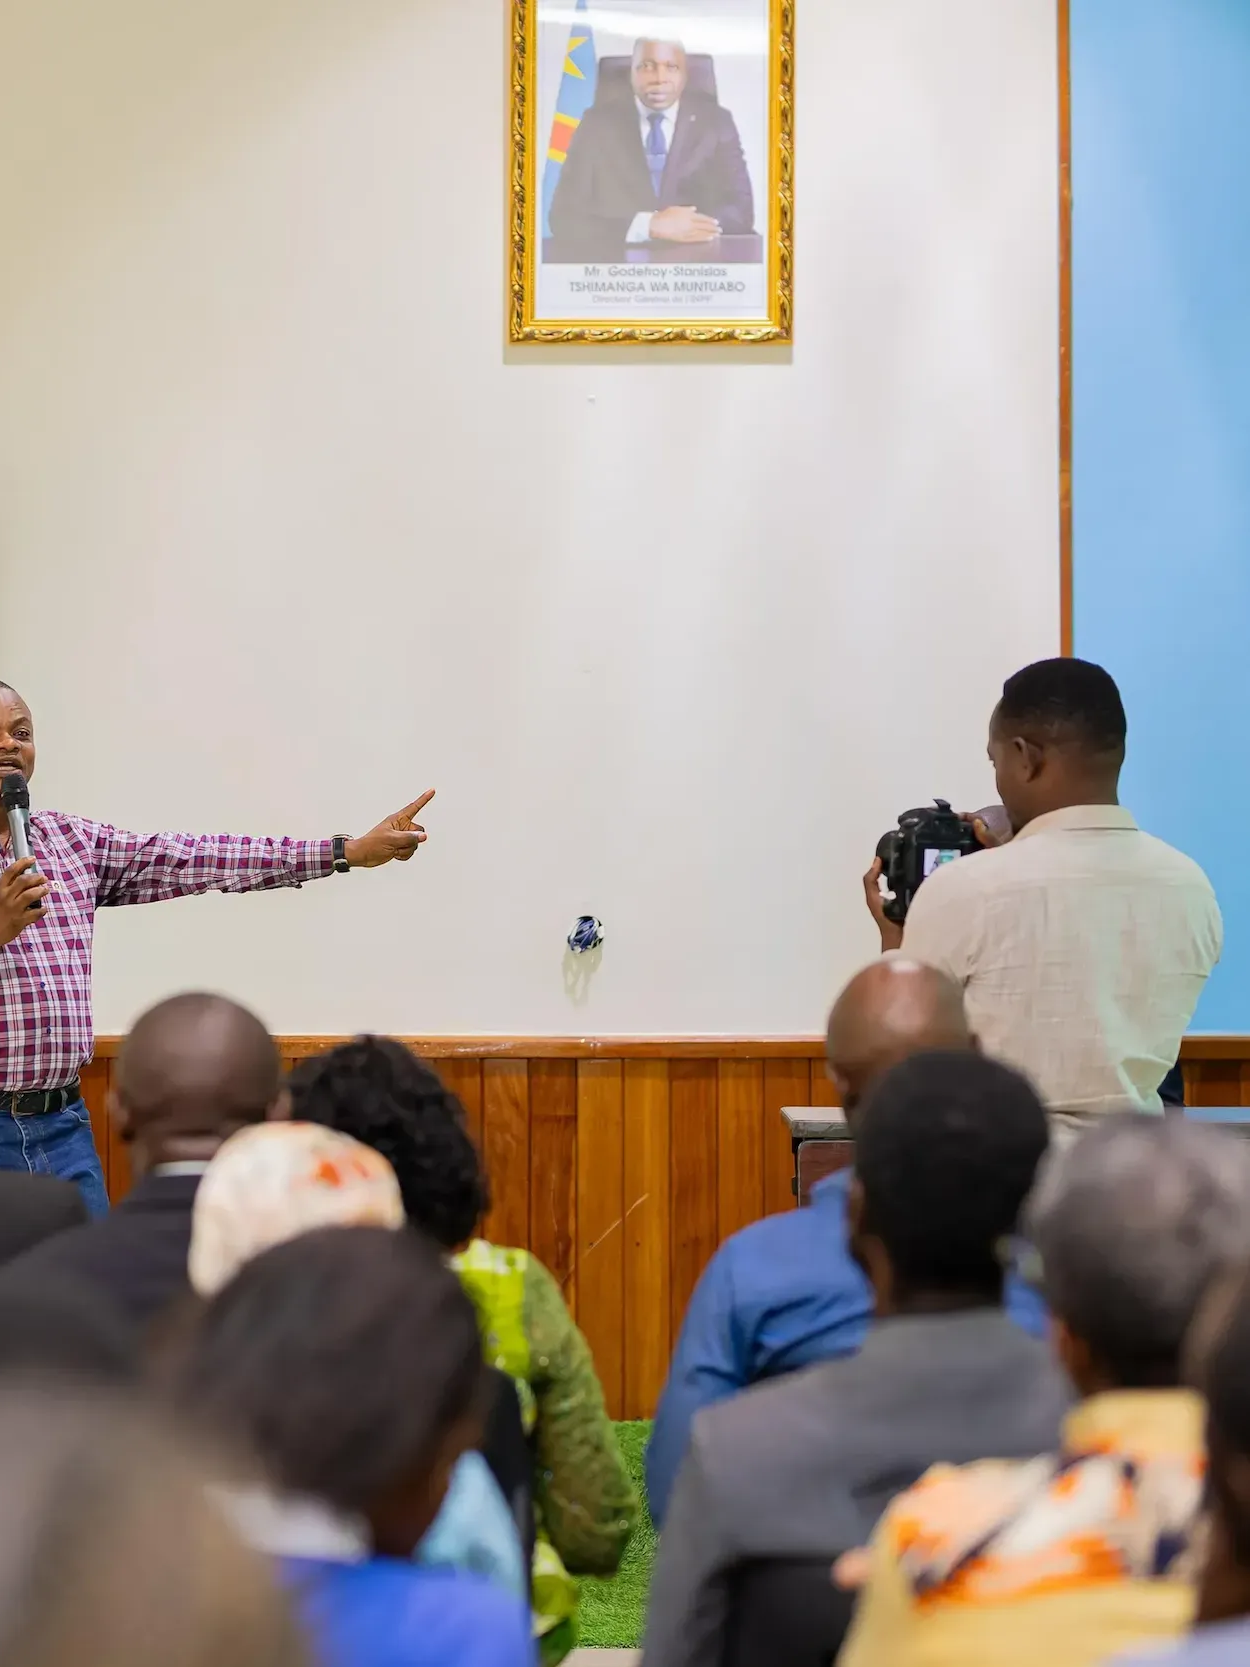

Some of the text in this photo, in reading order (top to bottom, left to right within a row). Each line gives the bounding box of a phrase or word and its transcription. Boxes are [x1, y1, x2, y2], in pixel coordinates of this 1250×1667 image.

[569, 281, 746, 293] TSHIMANGA WA MUNTUABO
